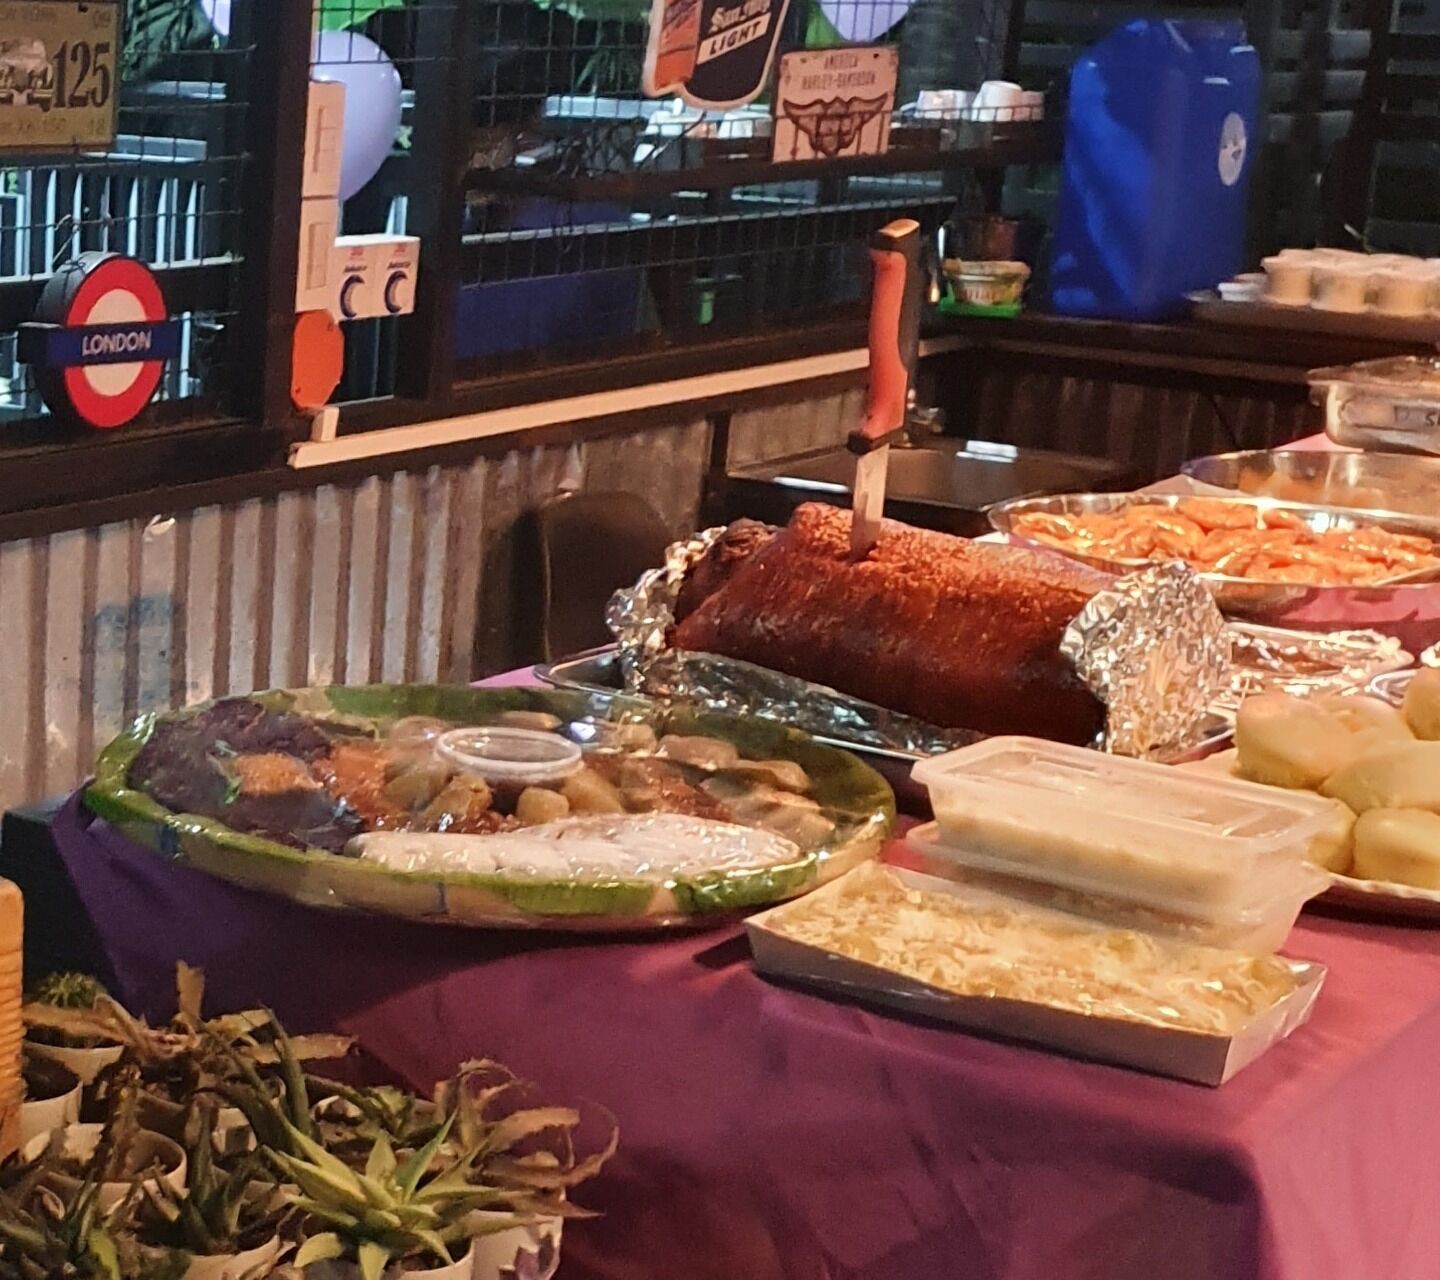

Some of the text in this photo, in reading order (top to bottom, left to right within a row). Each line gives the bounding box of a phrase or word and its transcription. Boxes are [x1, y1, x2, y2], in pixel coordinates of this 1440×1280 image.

[709, 20, 762, 55] LIGHT
[52, 40, 111, 108] 125
[81, 329, 152, 357] LONDON
